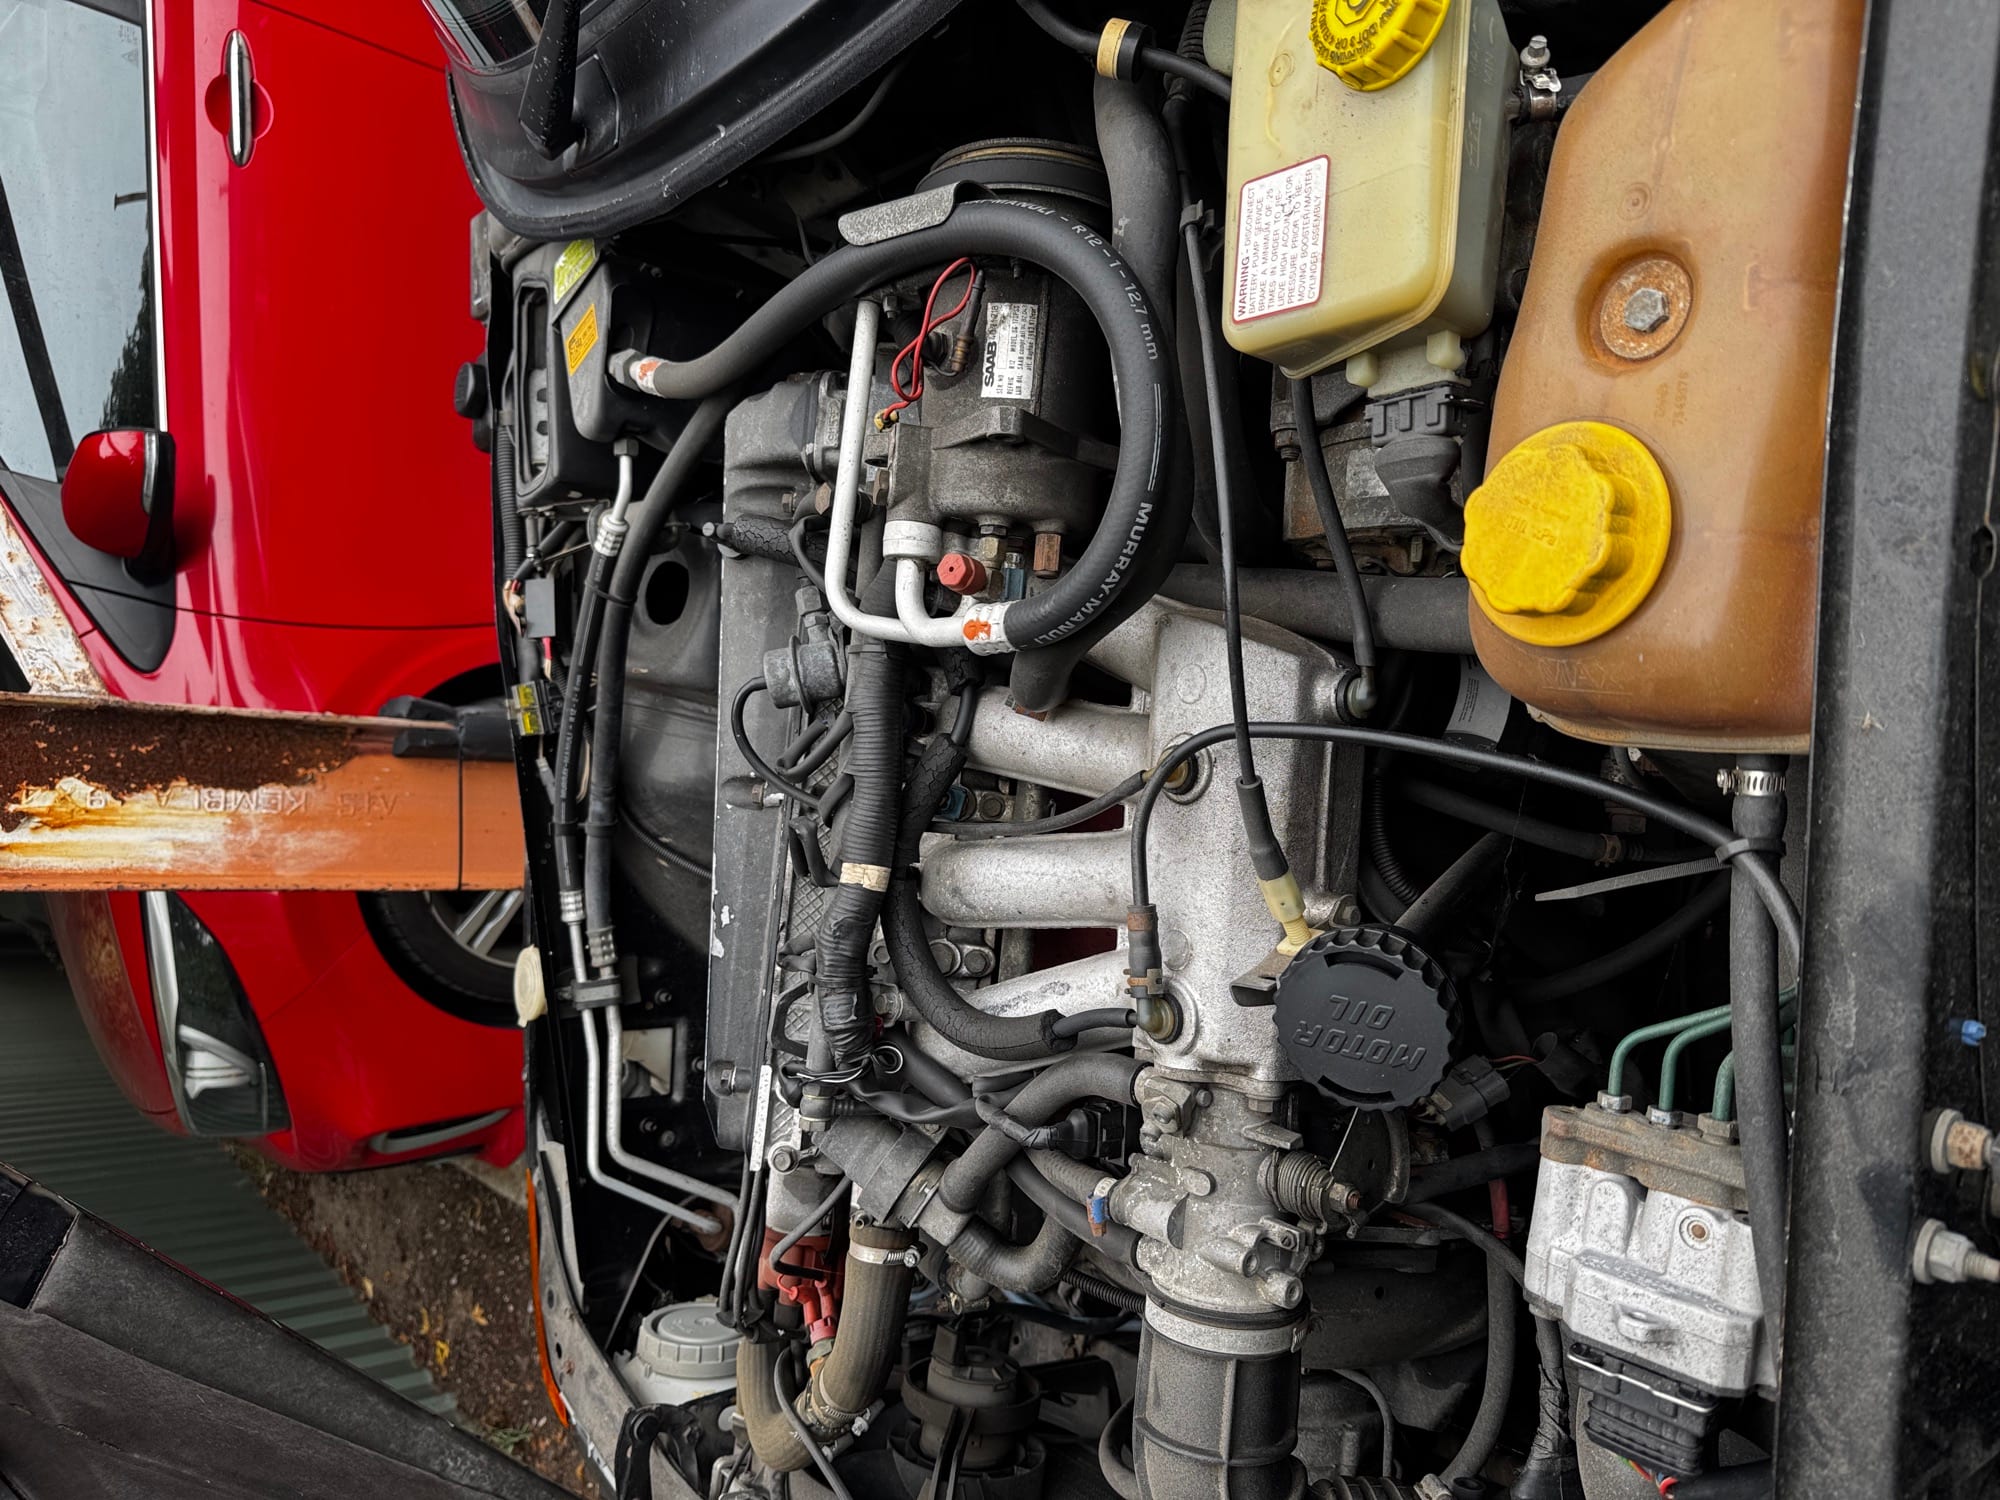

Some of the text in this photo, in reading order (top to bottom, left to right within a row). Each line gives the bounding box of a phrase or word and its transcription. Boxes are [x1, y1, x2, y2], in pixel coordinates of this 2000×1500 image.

[1253, 197, 1263, 236] SERVICE
[1265, 205, 1272, 217] OF
[1274, 211, 1281, 223] TO
[1293, 202, 1301, 214] TO
[1261, 222, 1271, 264] MINIMUM
[1271, 230, 1280, 262] ORDER
[1291, 219, 1299, 249] PRIOR
[1307, 195, 1321, 299] CYLINDER ASSEMBLY
[1238, 256, 1250, 317] WARNING
[1244, 188, 1255, 246] DISCONNECT
[1252, 241, 1260, 268] PUMP
[1280, 253, 1288, 276] HIGH
[1270, 267, 1277, 276] IN
[1287, 253, 1298, 304] PRESSURE
[1297, 263, 1307, 301] MOVING
[1071, 224, 1103, 248] R12
[1140, 323, 1159, 361] mm
[1258, 280, 1267, 311] BRAKE
[1268, 281, 1277, 309] TIMES
[1277, 282, 1286, 307] LIEVE
[984, 341, 997, 387] SAAB
[1033, 502, 1154, 645] MURRAY-MANULI
[1330, 995, 1395, 1030] OIL
[1291, 1020, 1427, 1071] MOTOR
